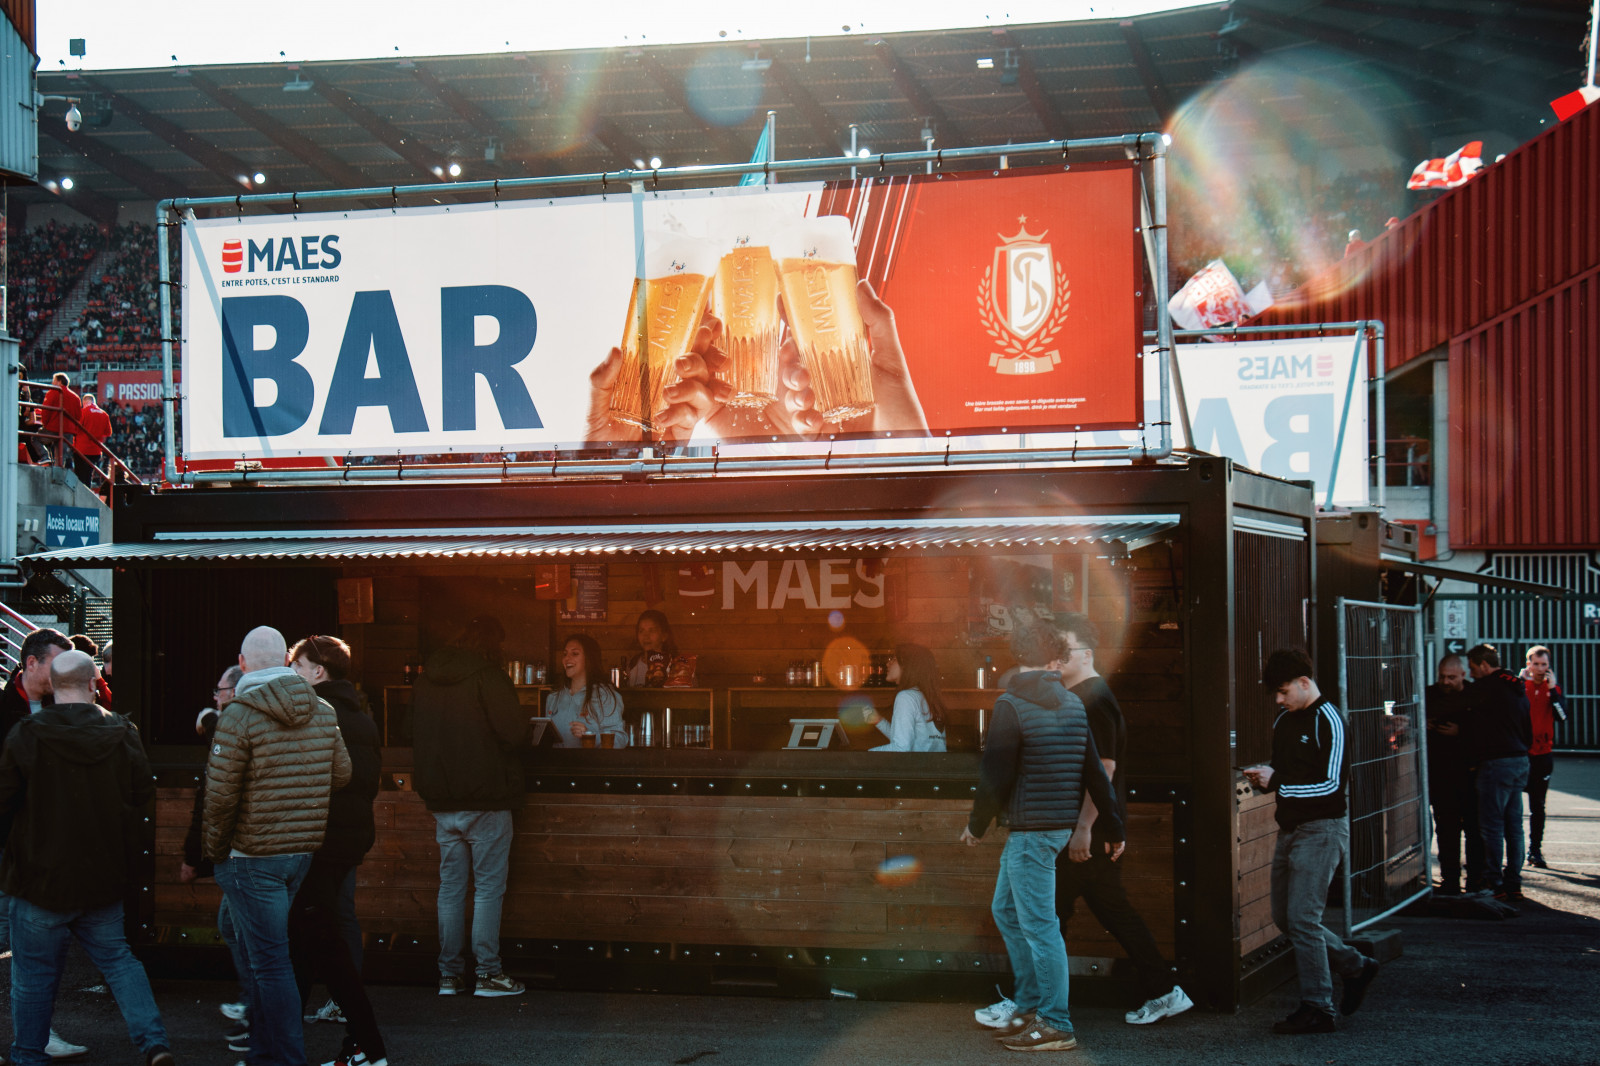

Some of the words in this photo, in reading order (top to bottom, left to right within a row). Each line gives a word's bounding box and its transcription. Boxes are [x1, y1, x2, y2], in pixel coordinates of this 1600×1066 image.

[247, 234, 342, 273] MAES
[221, 279, 243, 288] ENTRE
[245, 278, 270, 287] POTES,
[271, 276, 290, 286] C'EST
[292, 276, 301, 284] LE
[302, 275, 340, 284] STANDARD
[221, 284, 545, 438] BAR
[118, 383, 165, 400] PASSION
[47, 513, 65, 530] Accès
[65, 515, 84, 531] locaux
[85, 516, 99, 532] PMR
[721, 558, 885, 610] MAES
